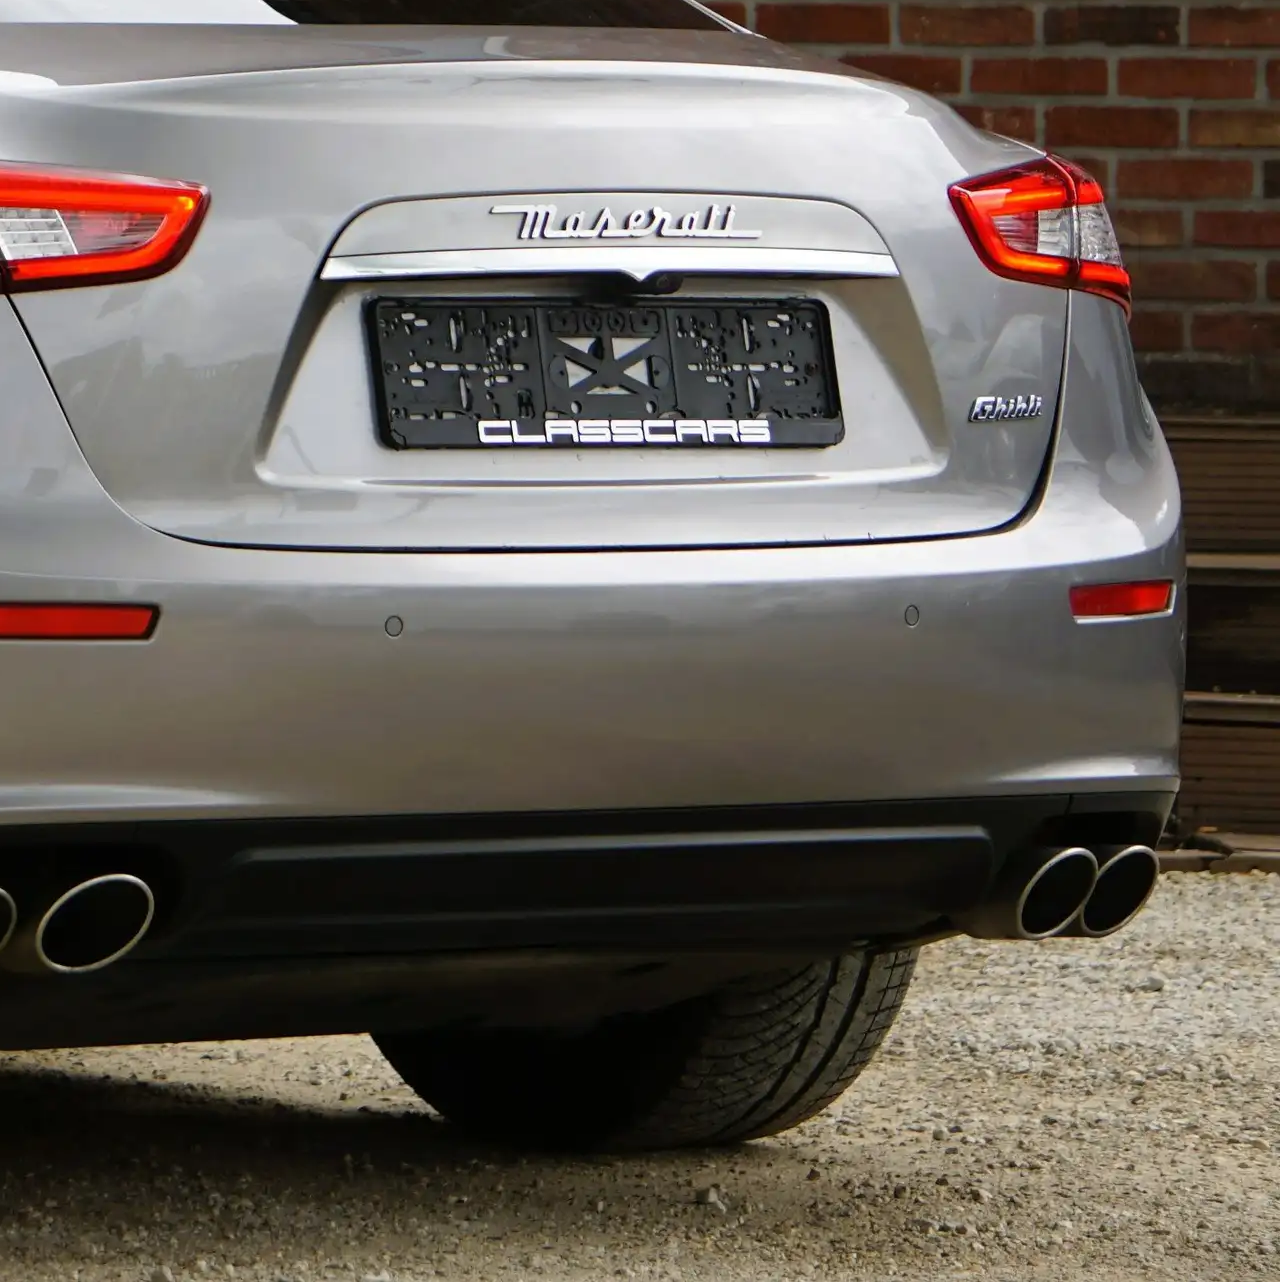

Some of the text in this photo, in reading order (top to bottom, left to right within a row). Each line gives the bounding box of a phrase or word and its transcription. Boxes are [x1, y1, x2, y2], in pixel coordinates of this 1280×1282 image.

[489, 203, 763, 239] Maserati
[969, 394, 1042, 422] Ghibli
[478, 419, 771, 443] CLASSCARS
